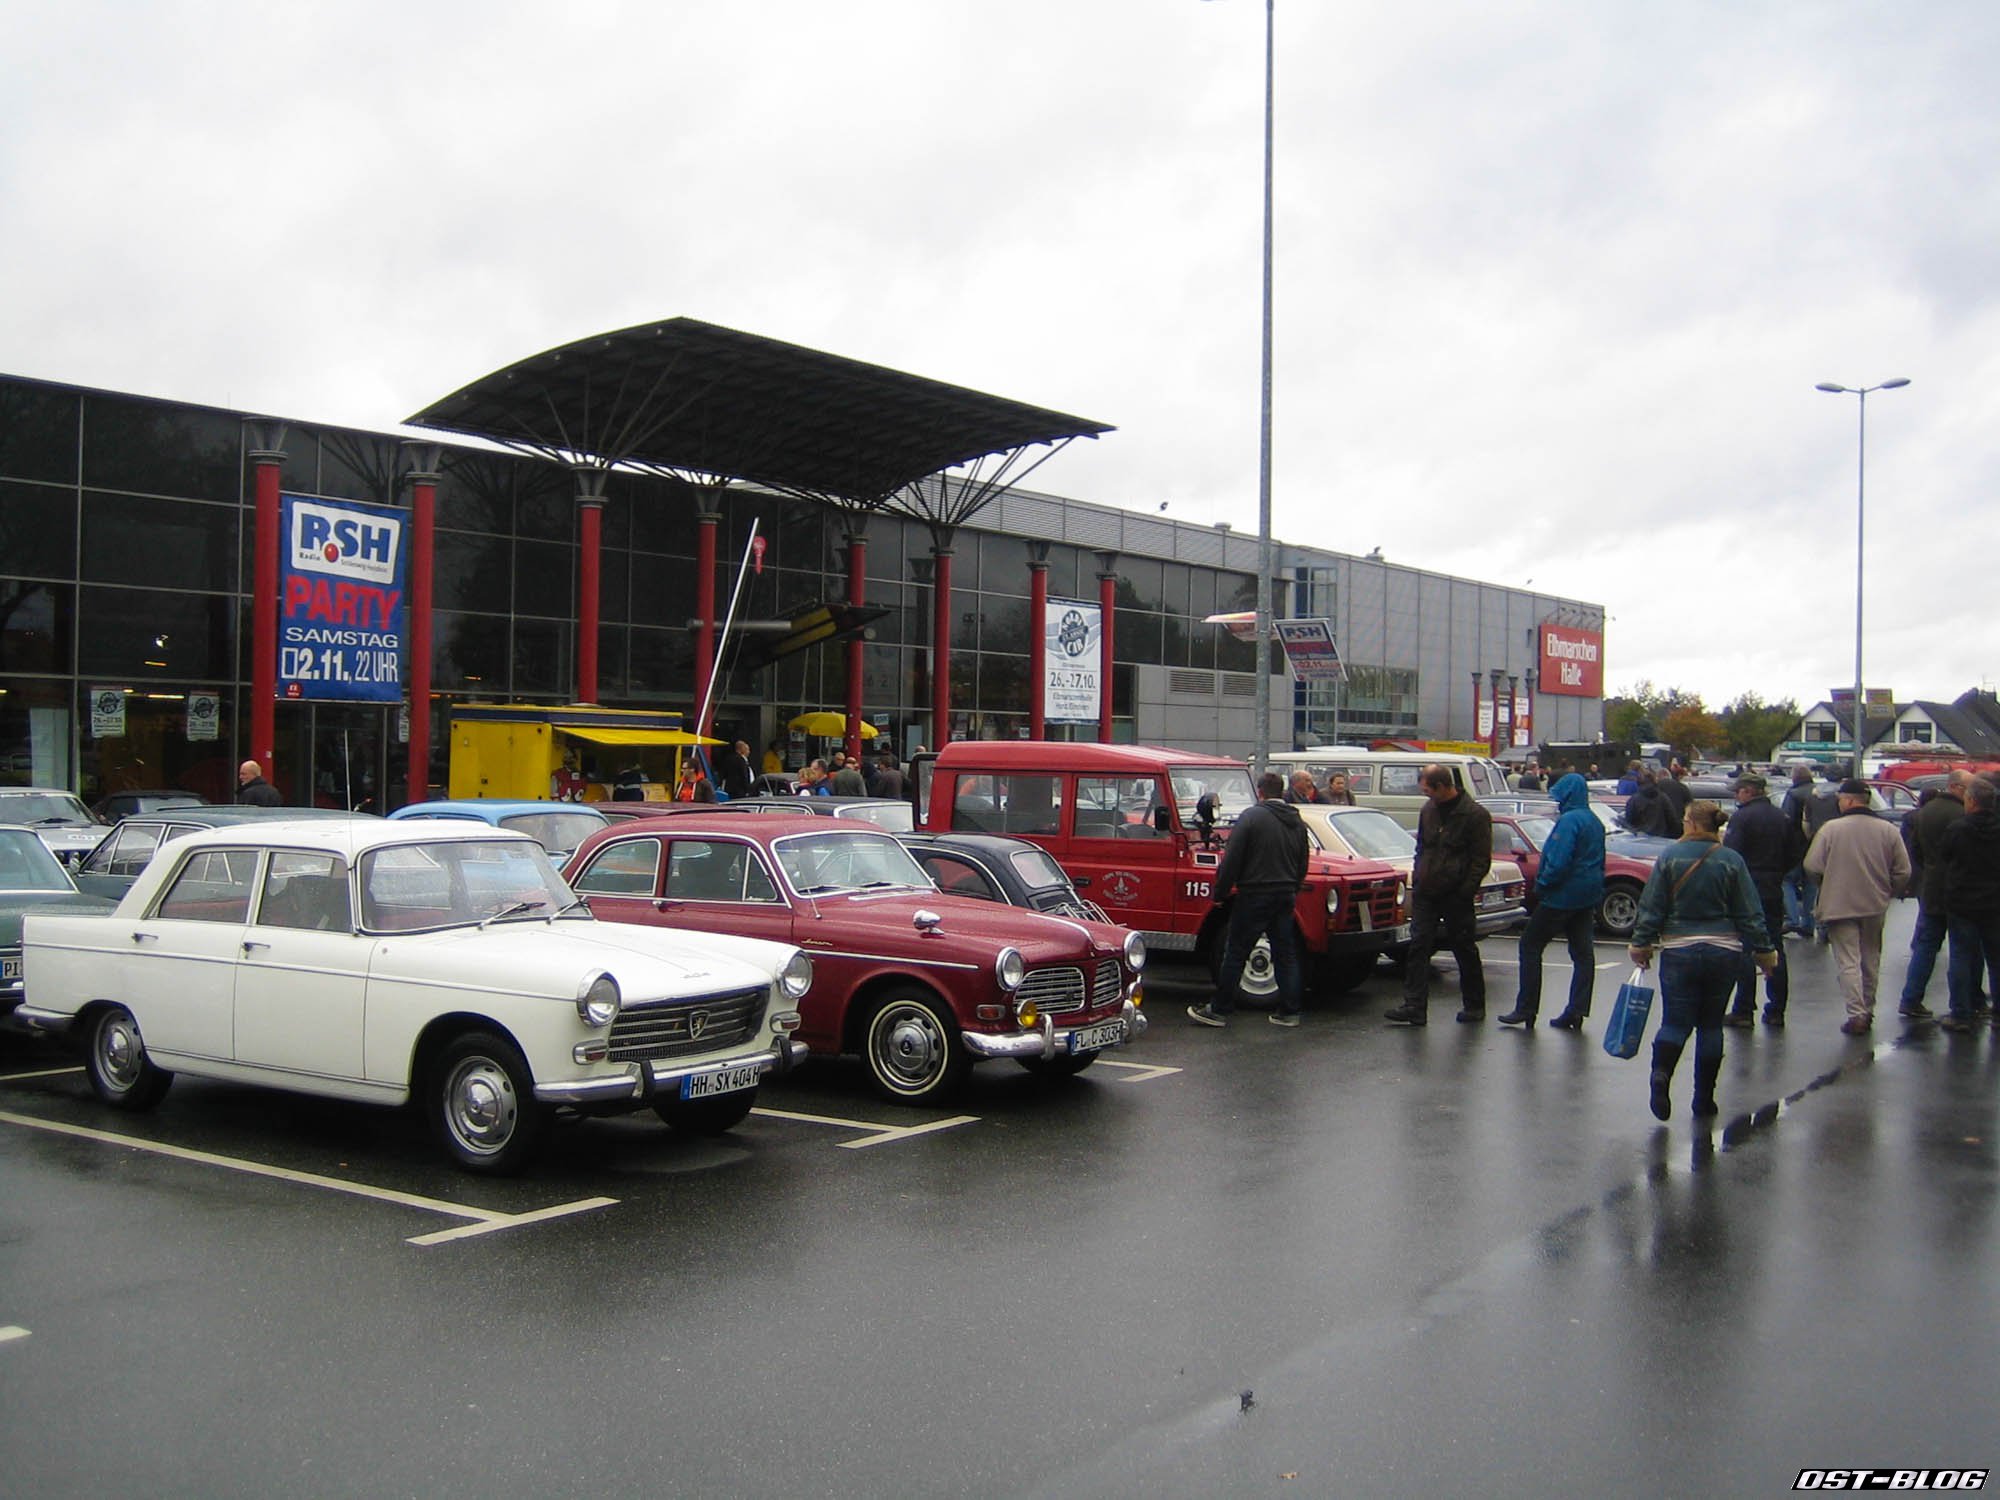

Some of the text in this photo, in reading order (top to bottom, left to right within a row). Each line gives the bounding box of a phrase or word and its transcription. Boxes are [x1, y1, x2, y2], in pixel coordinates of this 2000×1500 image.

[283, 574, 400, 630] PARTY
[285, 626, 398, 648] SAMSTAG
[354, 650, 371, 682] 22
[372, 651, 398, 683] UHR
[1560, 661, 1582, 686] Halle
[1185, 881, 1210, 897] 115
[4, 962, 19, 977] PI
[691, 1074, 709, 1096] HH
